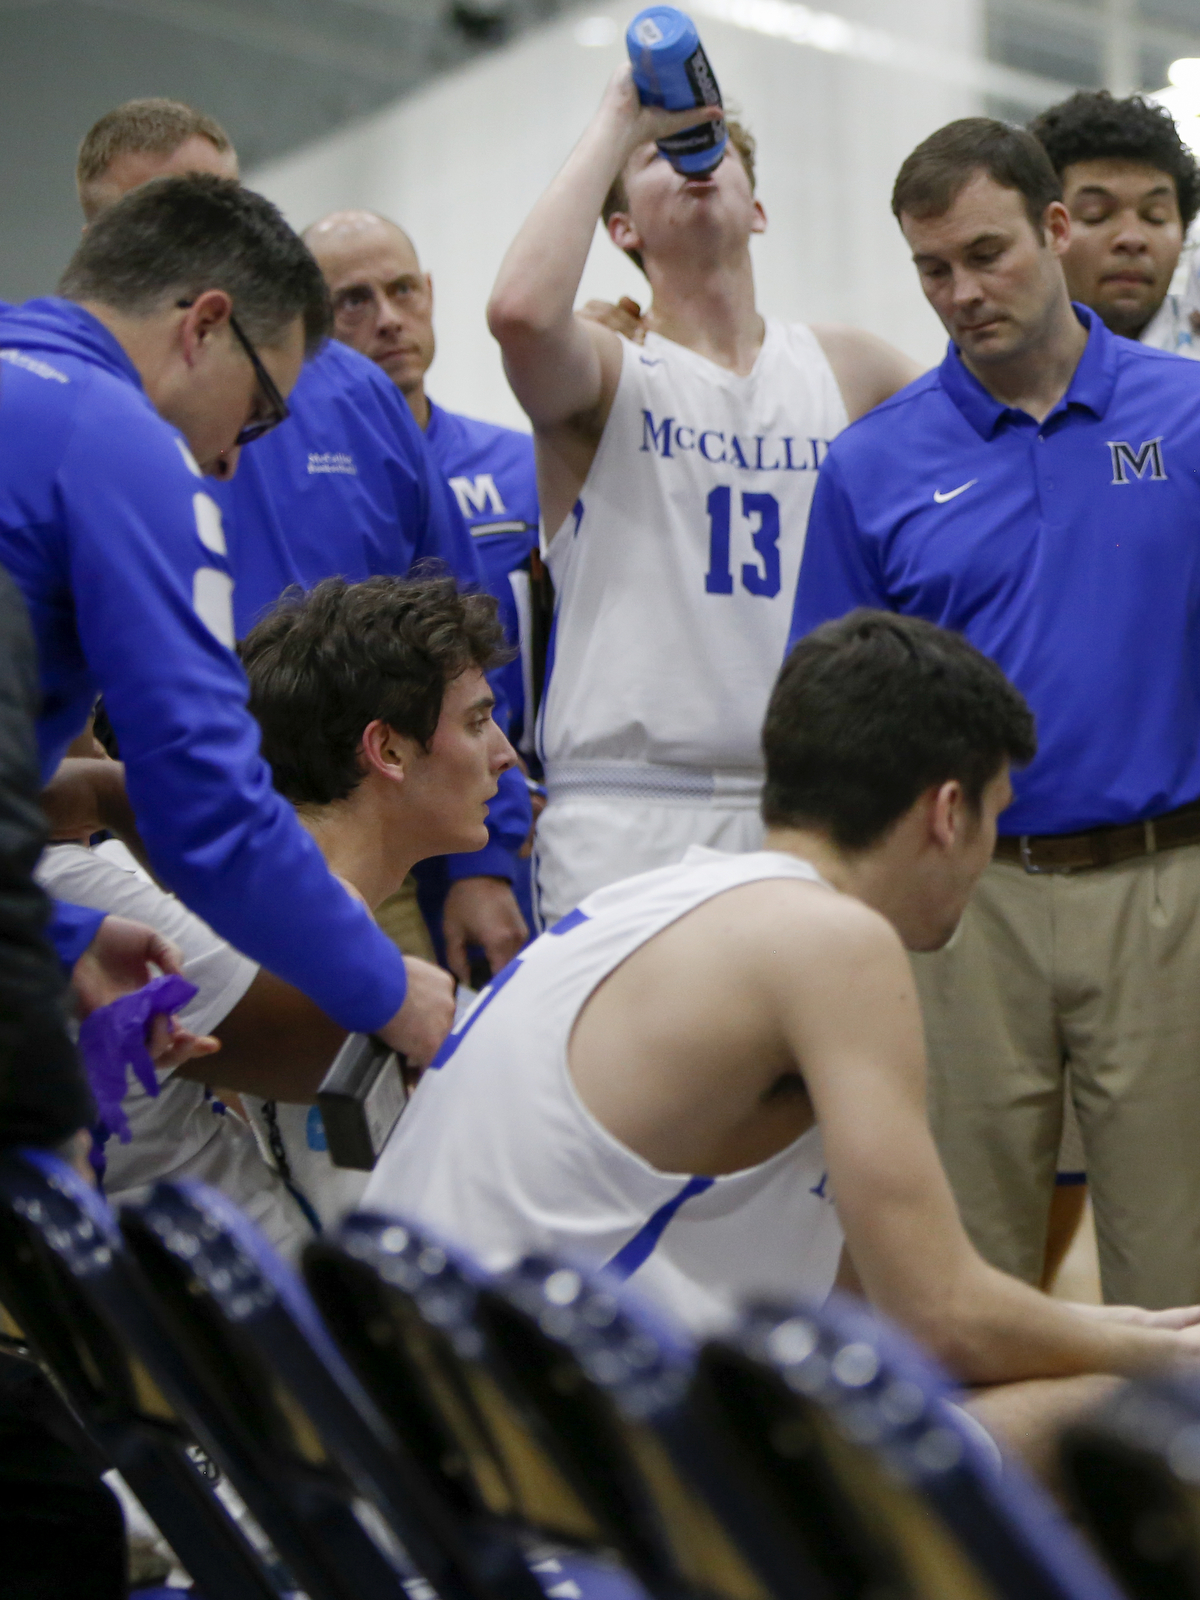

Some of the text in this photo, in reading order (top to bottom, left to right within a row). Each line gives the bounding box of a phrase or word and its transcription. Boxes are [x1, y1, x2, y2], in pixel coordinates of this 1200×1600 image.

[639, 408, 833, 471] McCALLI
[1104, 435, 1168, 485] M
[448, 473, 507, 519] M
[704, 484, 781, 600] 13
